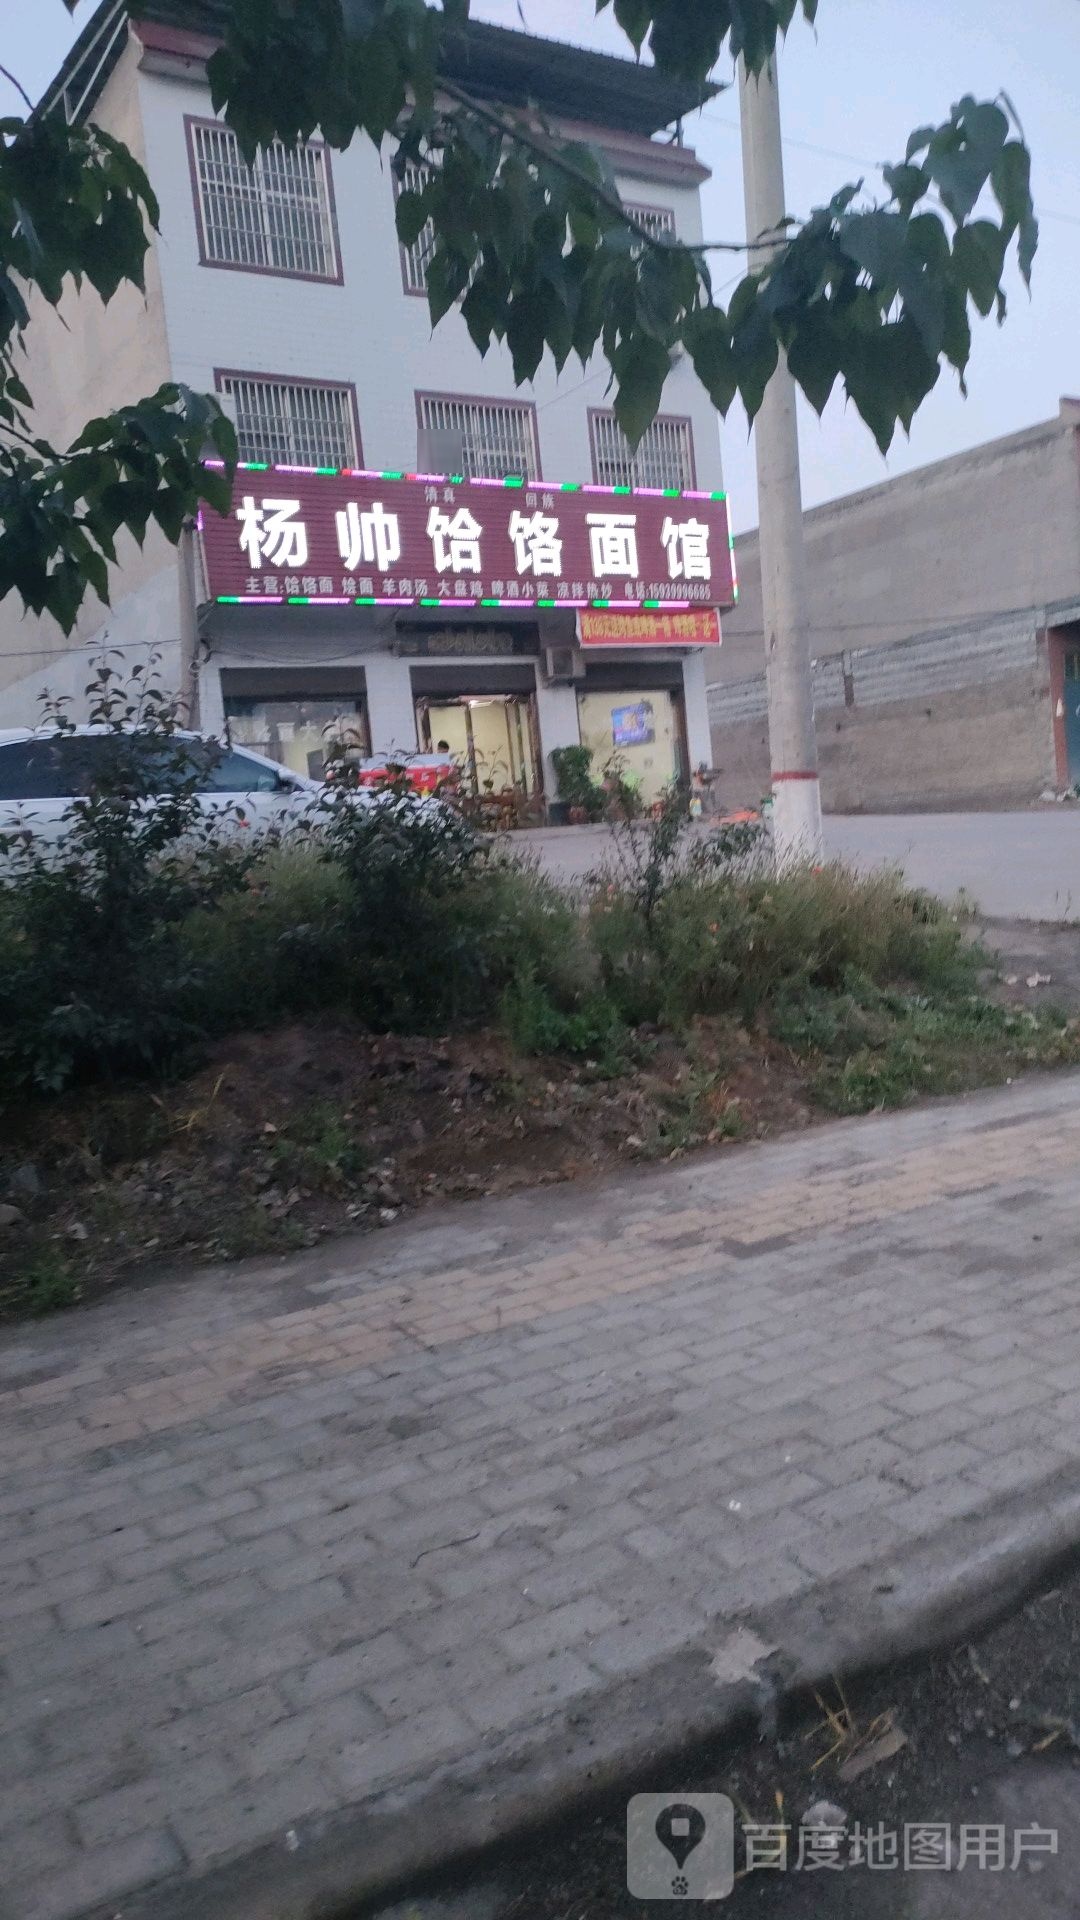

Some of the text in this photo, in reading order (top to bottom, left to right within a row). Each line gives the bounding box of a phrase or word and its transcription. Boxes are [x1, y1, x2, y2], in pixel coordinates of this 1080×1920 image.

[424, 485, 555, 510] 清真 回族
[236, 495, 712, 580] 杨帅饸饹面馆
[342, 576, 373, 596] 烩面
[382, 578, 428, 597] 羊肉汤
[437, 578, 484, 598] 大盘鸡
[491, 579, 549, 599] 啤酒小菜
